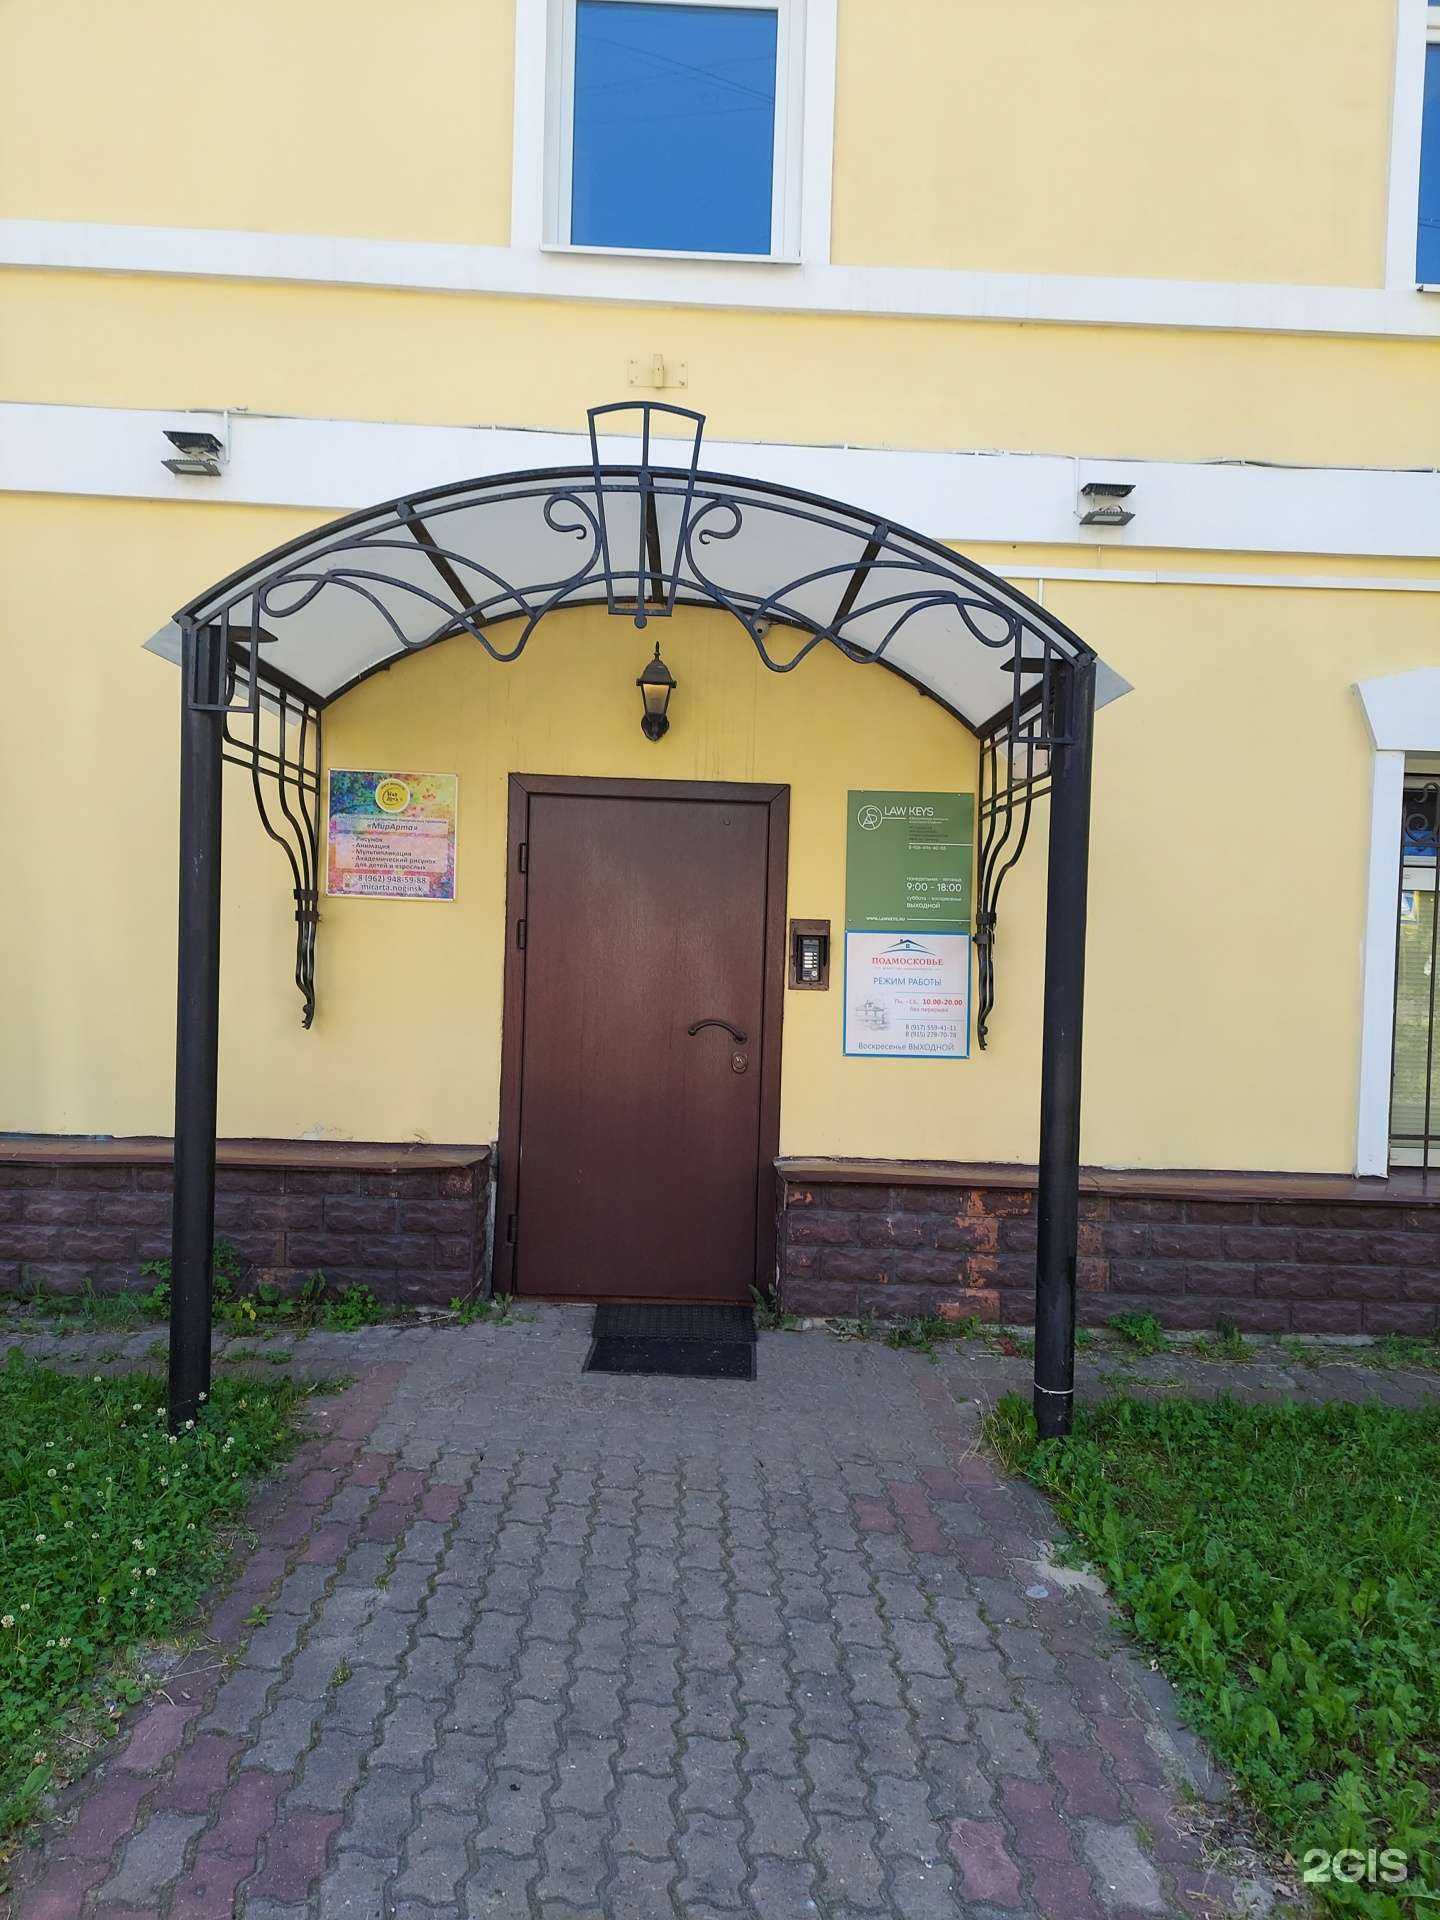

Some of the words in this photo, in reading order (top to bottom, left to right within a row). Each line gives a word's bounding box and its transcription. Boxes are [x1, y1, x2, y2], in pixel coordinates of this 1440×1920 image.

[884, 806, 906, 816] LAW
[909, 806, 934, 816] KEYS
[356, 842, 390, 850] Анимация
[906, 882, 928, 892] 9:00
[937, 882, 962, 893] 18:00
[872, 957, 944, 966] ПОДМОСКОВЬЕ
[873, 977, 906, 986] РЕЖИМ
[908, 977, 942, 986] РАБОТЫ
[858, 1041, 907, 1051] Воскресенье
[908, 1042, 954, 1053] ВЫХОДНОЙ
